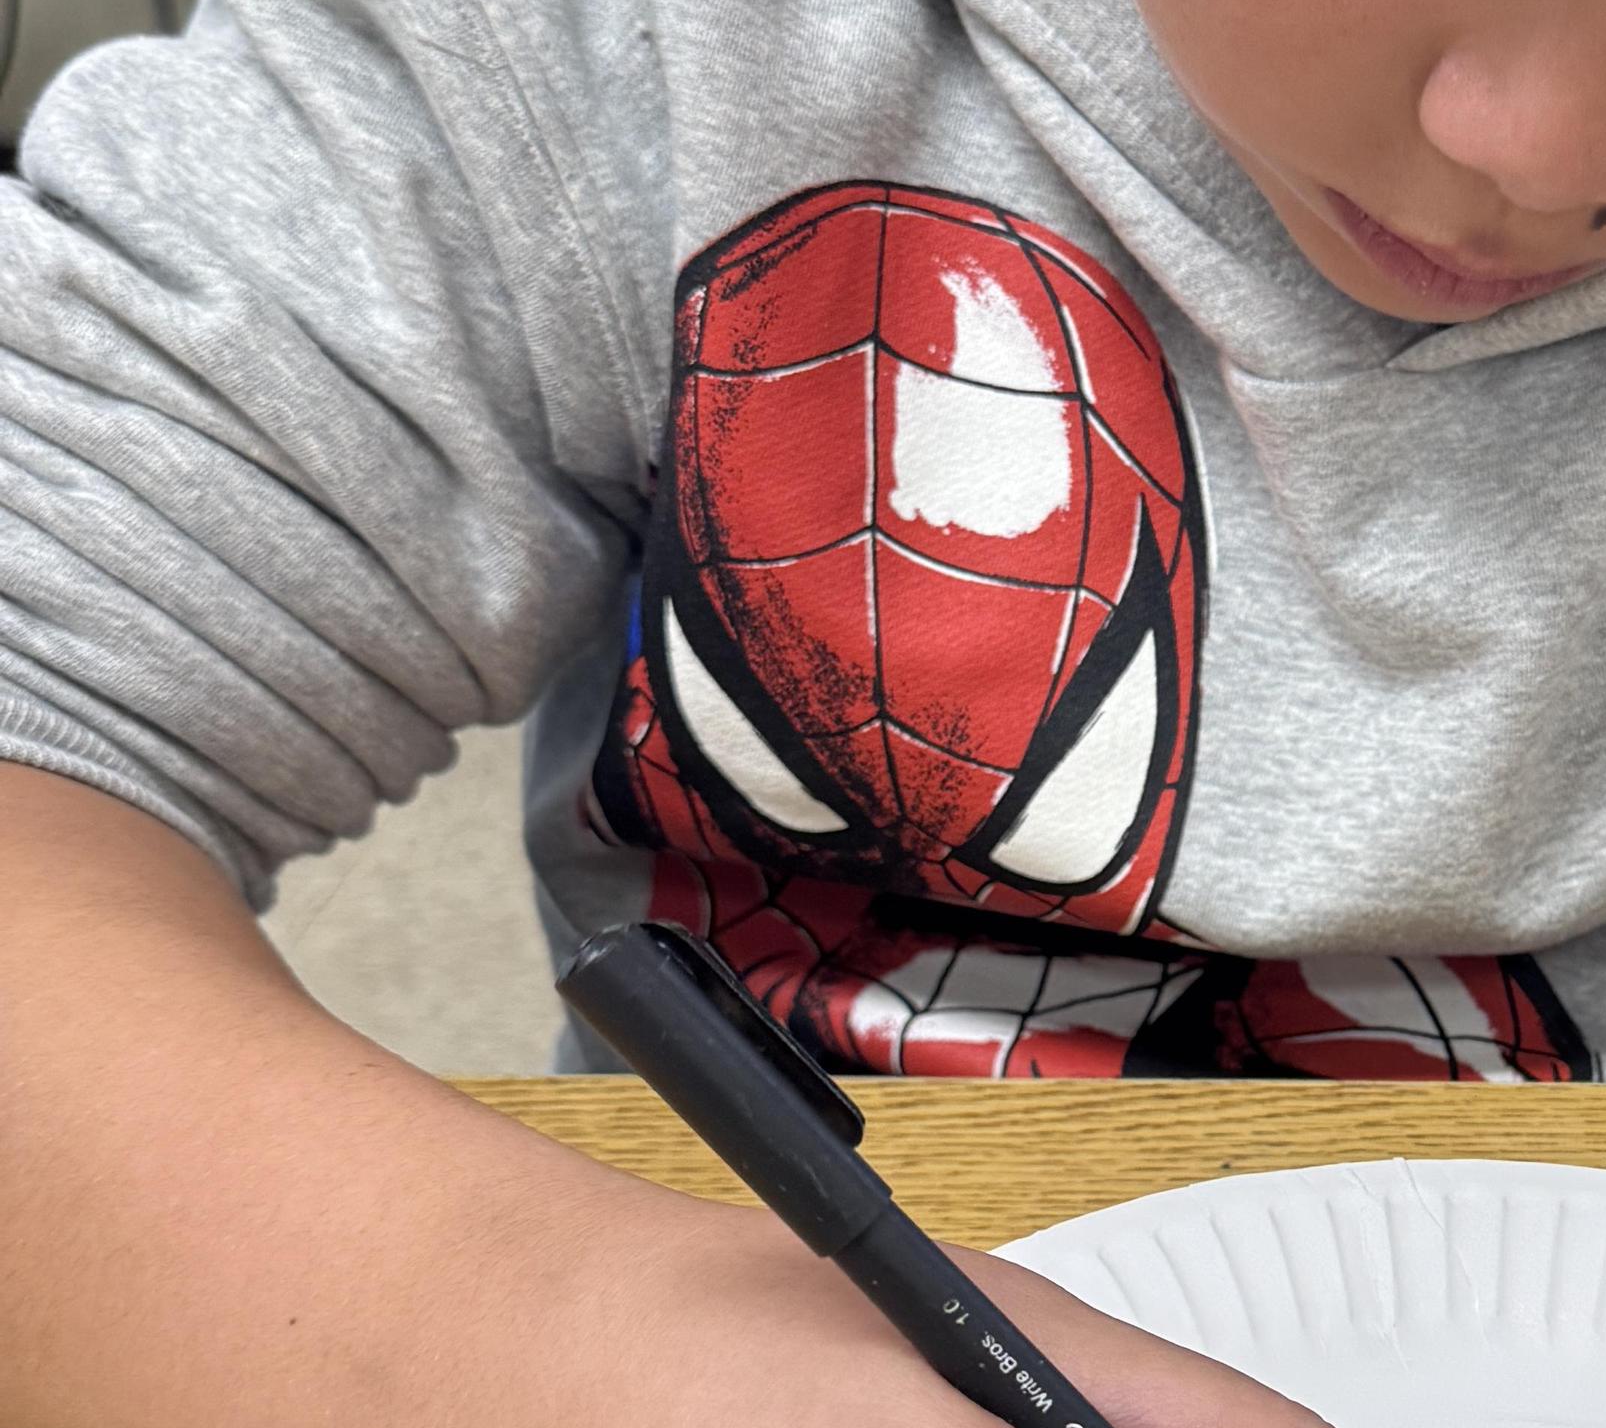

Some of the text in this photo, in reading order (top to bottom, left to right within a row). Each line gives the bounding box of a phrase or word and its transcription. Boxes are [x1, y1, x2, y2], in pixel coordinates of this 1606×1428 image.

[942, 1298, 970, 1325] 1.0
[981, 1330, 1019, 1375] Bros.
[1015, 1369, 1054, 1414] Write
